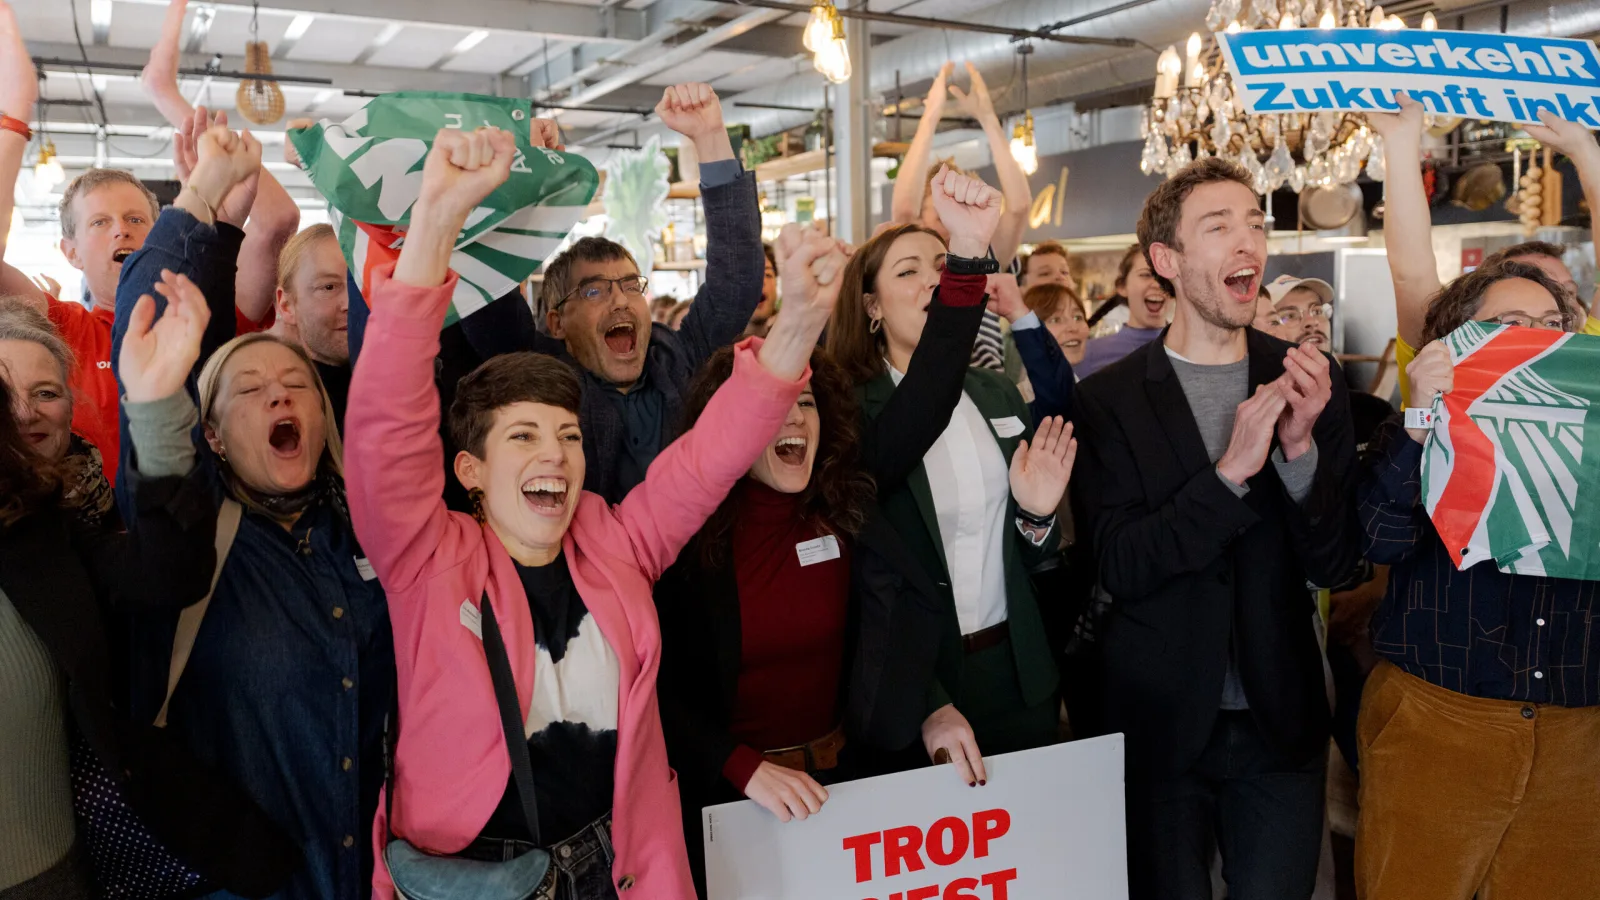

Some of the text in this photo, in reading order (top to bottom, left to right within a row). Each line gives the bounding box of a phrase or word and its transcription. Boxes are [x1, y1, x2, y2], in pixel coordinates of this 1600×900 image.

[1241, 38, 1596, 79] umverkehR
[1246, 80, 1495, 117] Zukunft
[842, 808, 1011, 883] TROP
